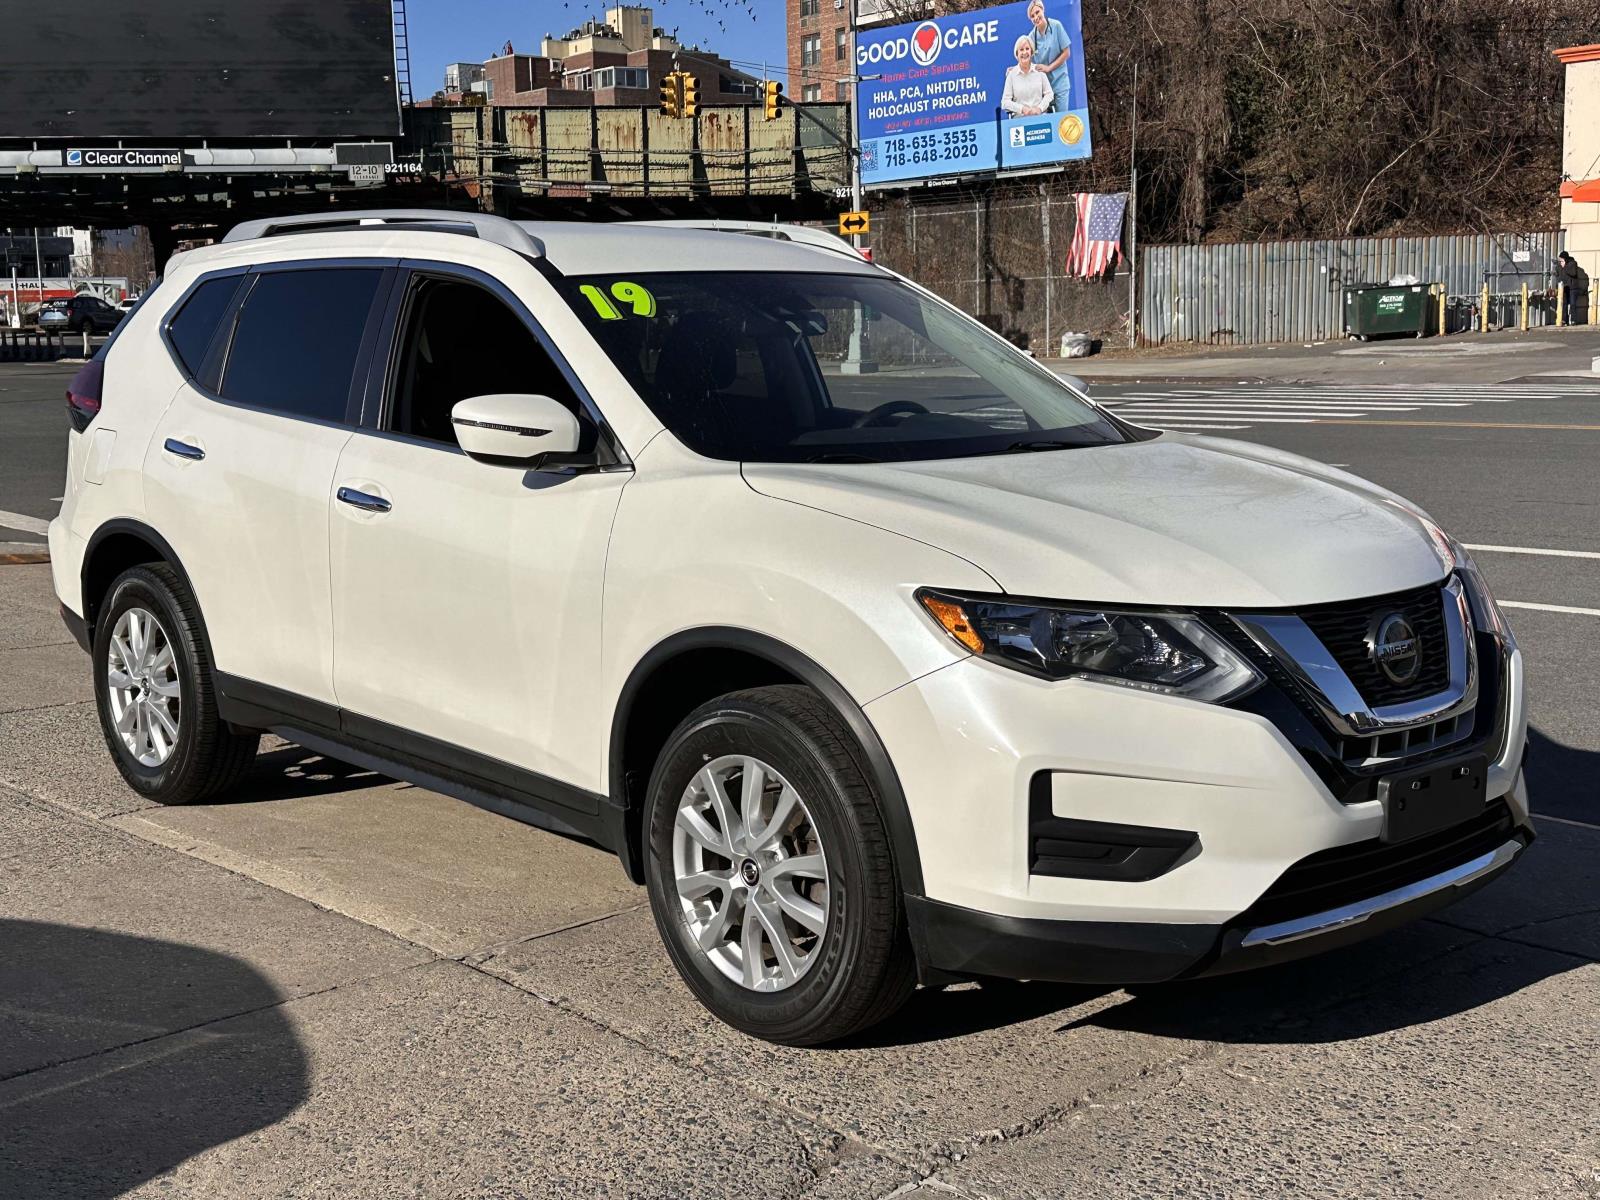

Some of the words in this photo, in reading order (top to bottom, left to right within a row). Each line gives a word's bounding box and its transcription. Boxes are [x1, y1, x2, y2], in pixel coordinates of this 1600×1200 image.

[857, 38, 909, 66] GOOD
[944, 19, 999, 49] CARE
[908, 66, 929, 79] Care
[931, 60, 970, 75] Services
[873, 90, 897, 104] HHA,
[900, 85, 924, 99] PCA,
[926, 76, 980, 95] NHTD/TBI,
[868, 100, 929, 120] HOLOCAUST
[932, 91, 987, 109] PROGRAM
[884, 128, 977, 153] 718-635-3535
[85, 151, 122, 164] Clear
[124, 151, 182, 164] Channel
[384, 162, 422, 173] 921164
[885, 143, 979, 168] 718-648-2020
[579, 281, 657, 320] 19
